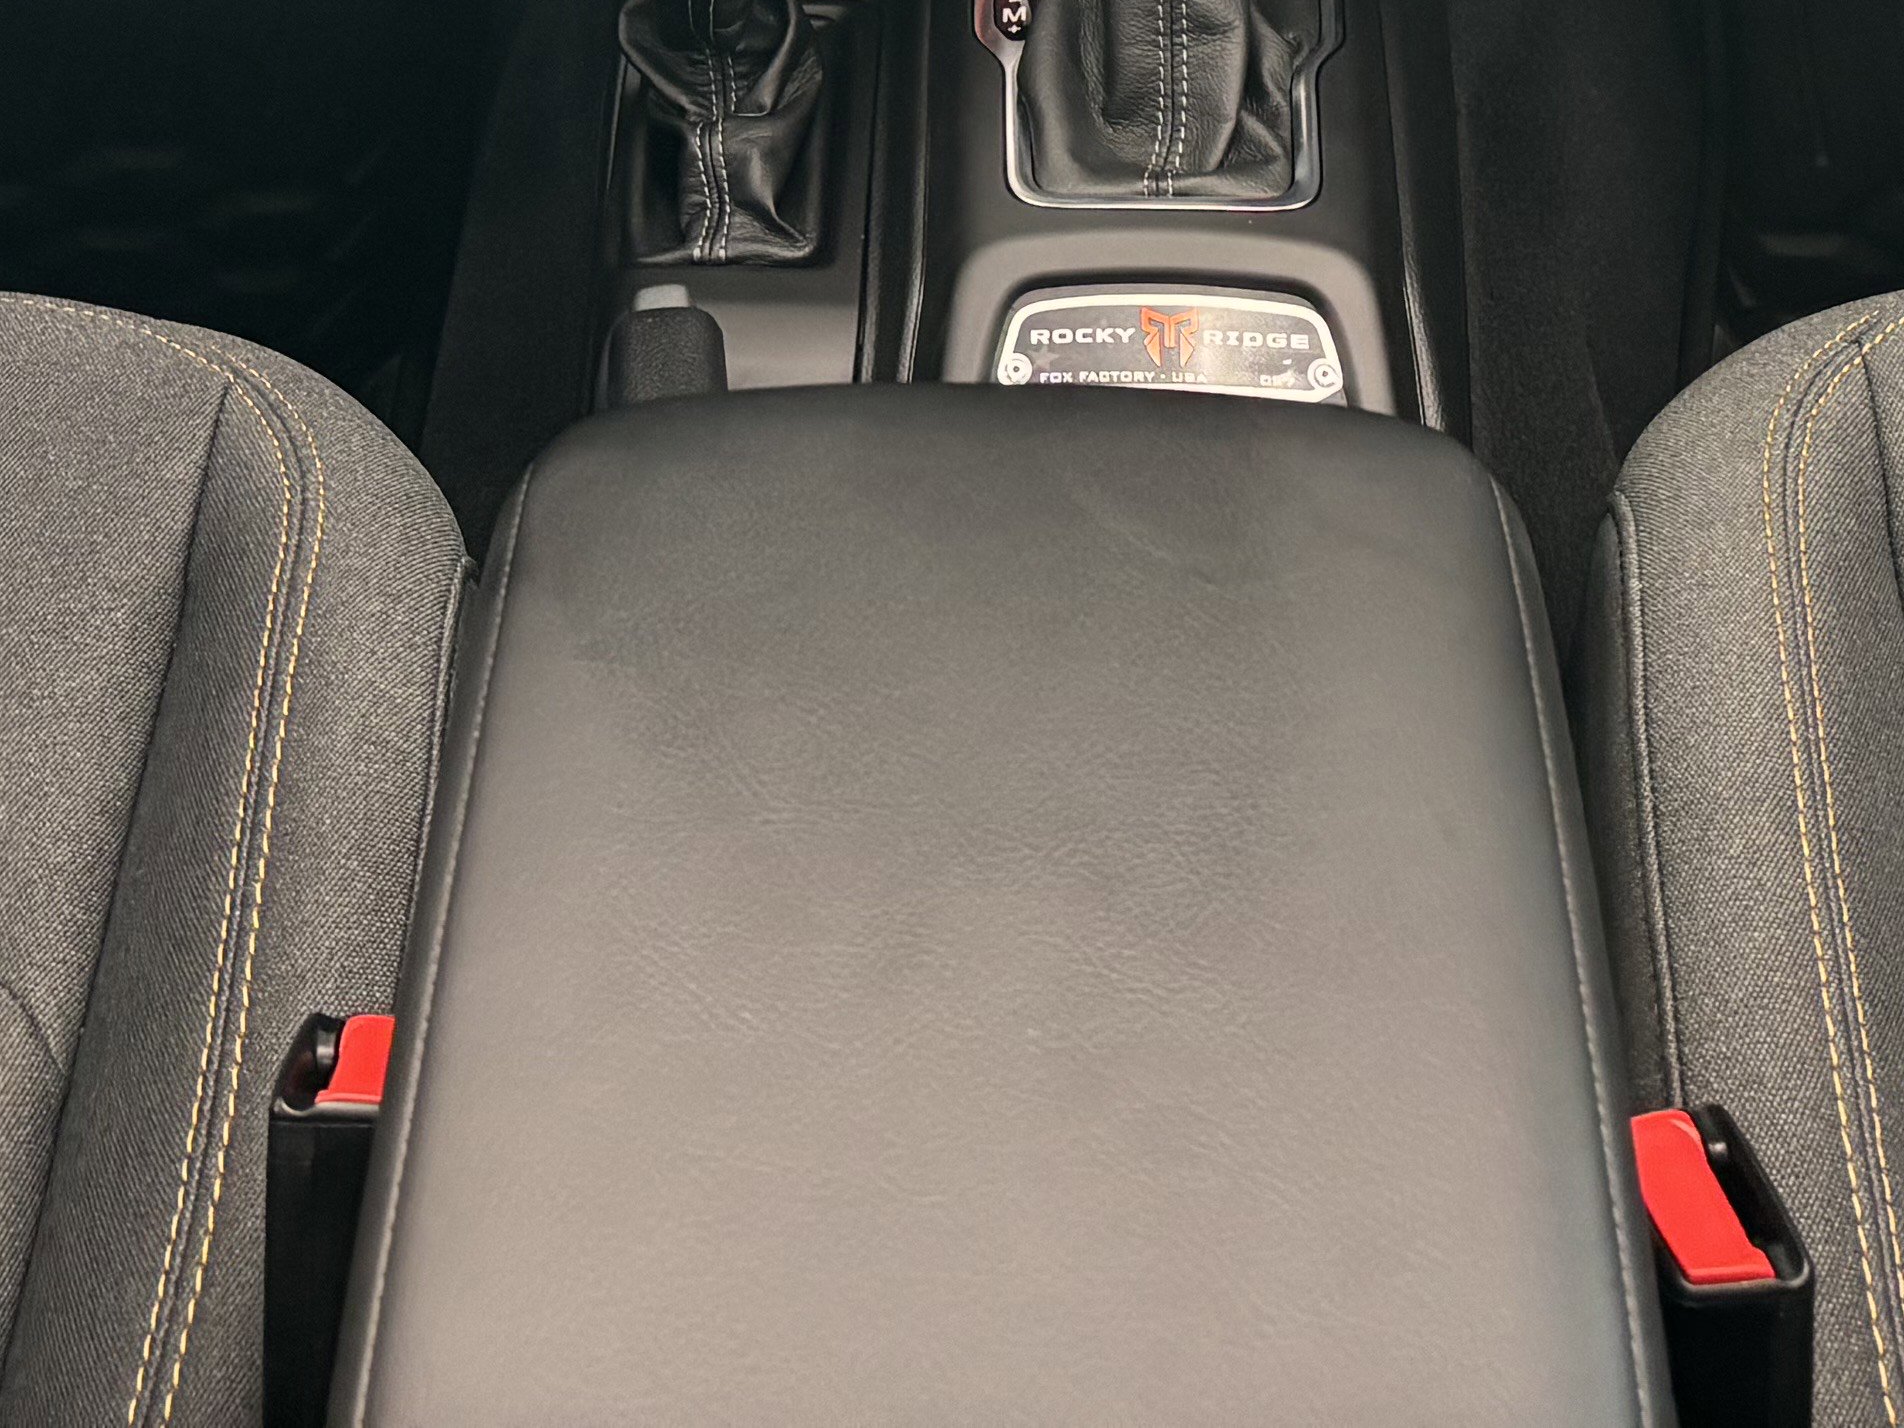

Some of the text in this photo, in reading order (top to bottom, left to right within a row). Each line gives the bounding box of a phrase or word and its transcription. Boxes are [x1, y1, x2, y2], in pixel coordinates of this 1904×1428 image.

[1002, 5, 1027, 23] M
[1029, 327, 1311, 351] ROCKY RIDGE
[1039, 372, 1074, 385] FOX
[1078, 370, 1156, 384] FACTORY
